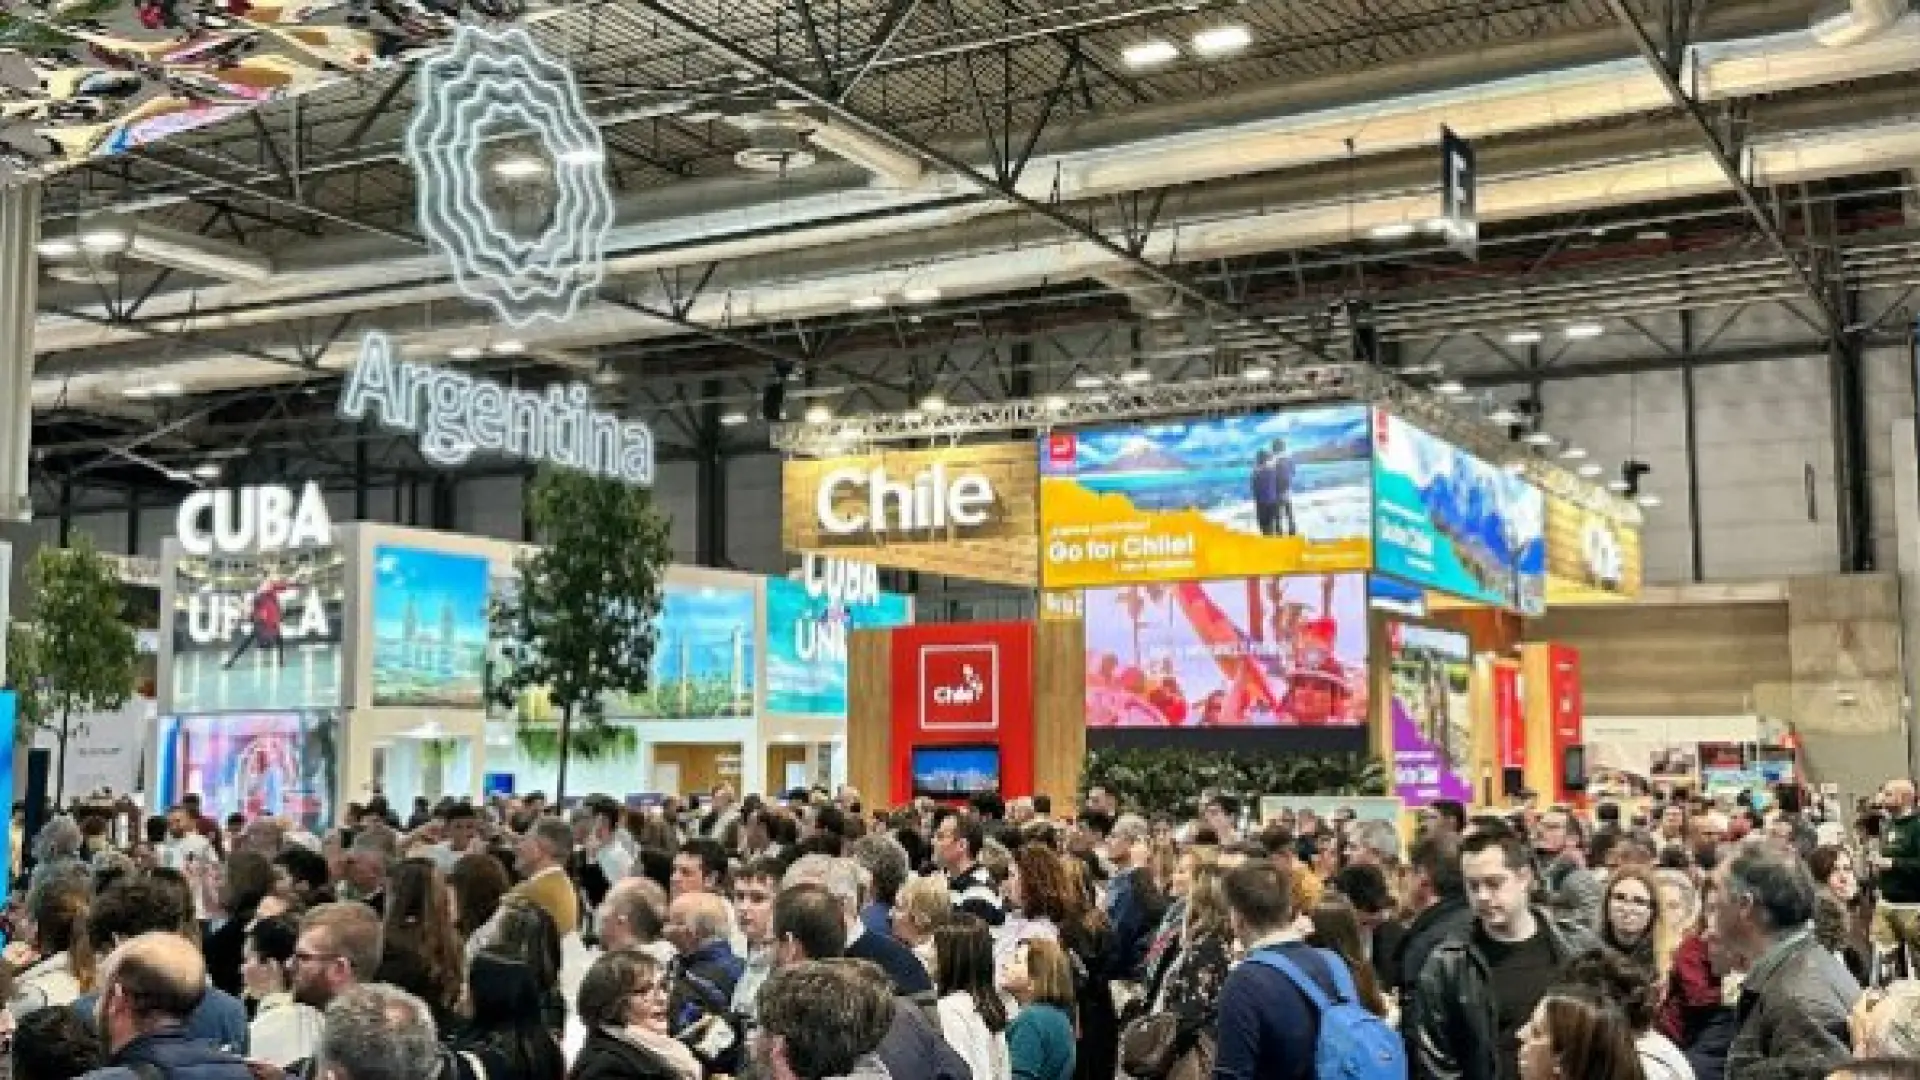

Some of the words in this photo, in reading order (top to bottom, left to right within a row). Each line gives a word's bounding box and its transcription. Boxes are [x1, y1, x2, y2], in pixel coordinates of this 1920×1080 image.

[340, 329, 654, 484] Argentina
[178, 482, 332, 551] CUBA
[818, 462, 995, 532] Chile
